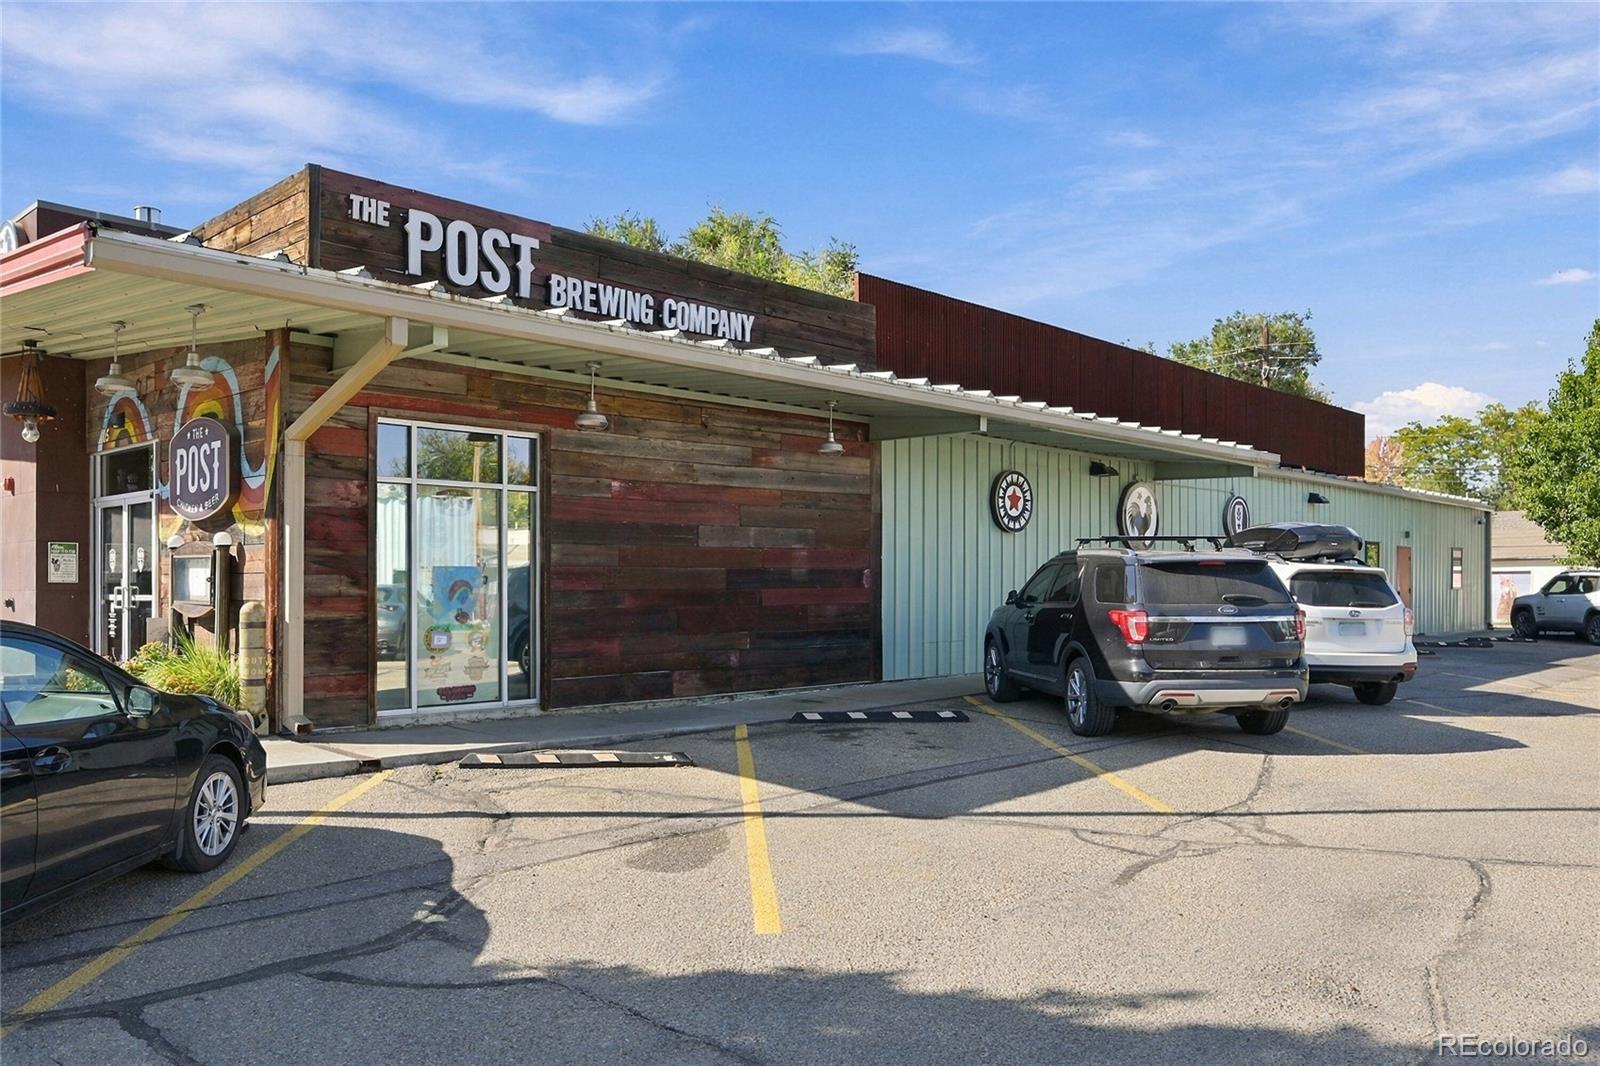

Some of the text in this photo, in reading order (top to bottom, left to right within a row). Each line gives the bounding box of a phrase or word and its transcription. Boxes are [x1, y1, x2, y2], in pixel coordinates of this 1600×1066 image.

[349, 193, 755, 343] THE POST BREWING COMPANY
[193, 427, 204, 440] THE
[175, 440, 222, 496] POST
[204, 493, 220, 510] BEER
